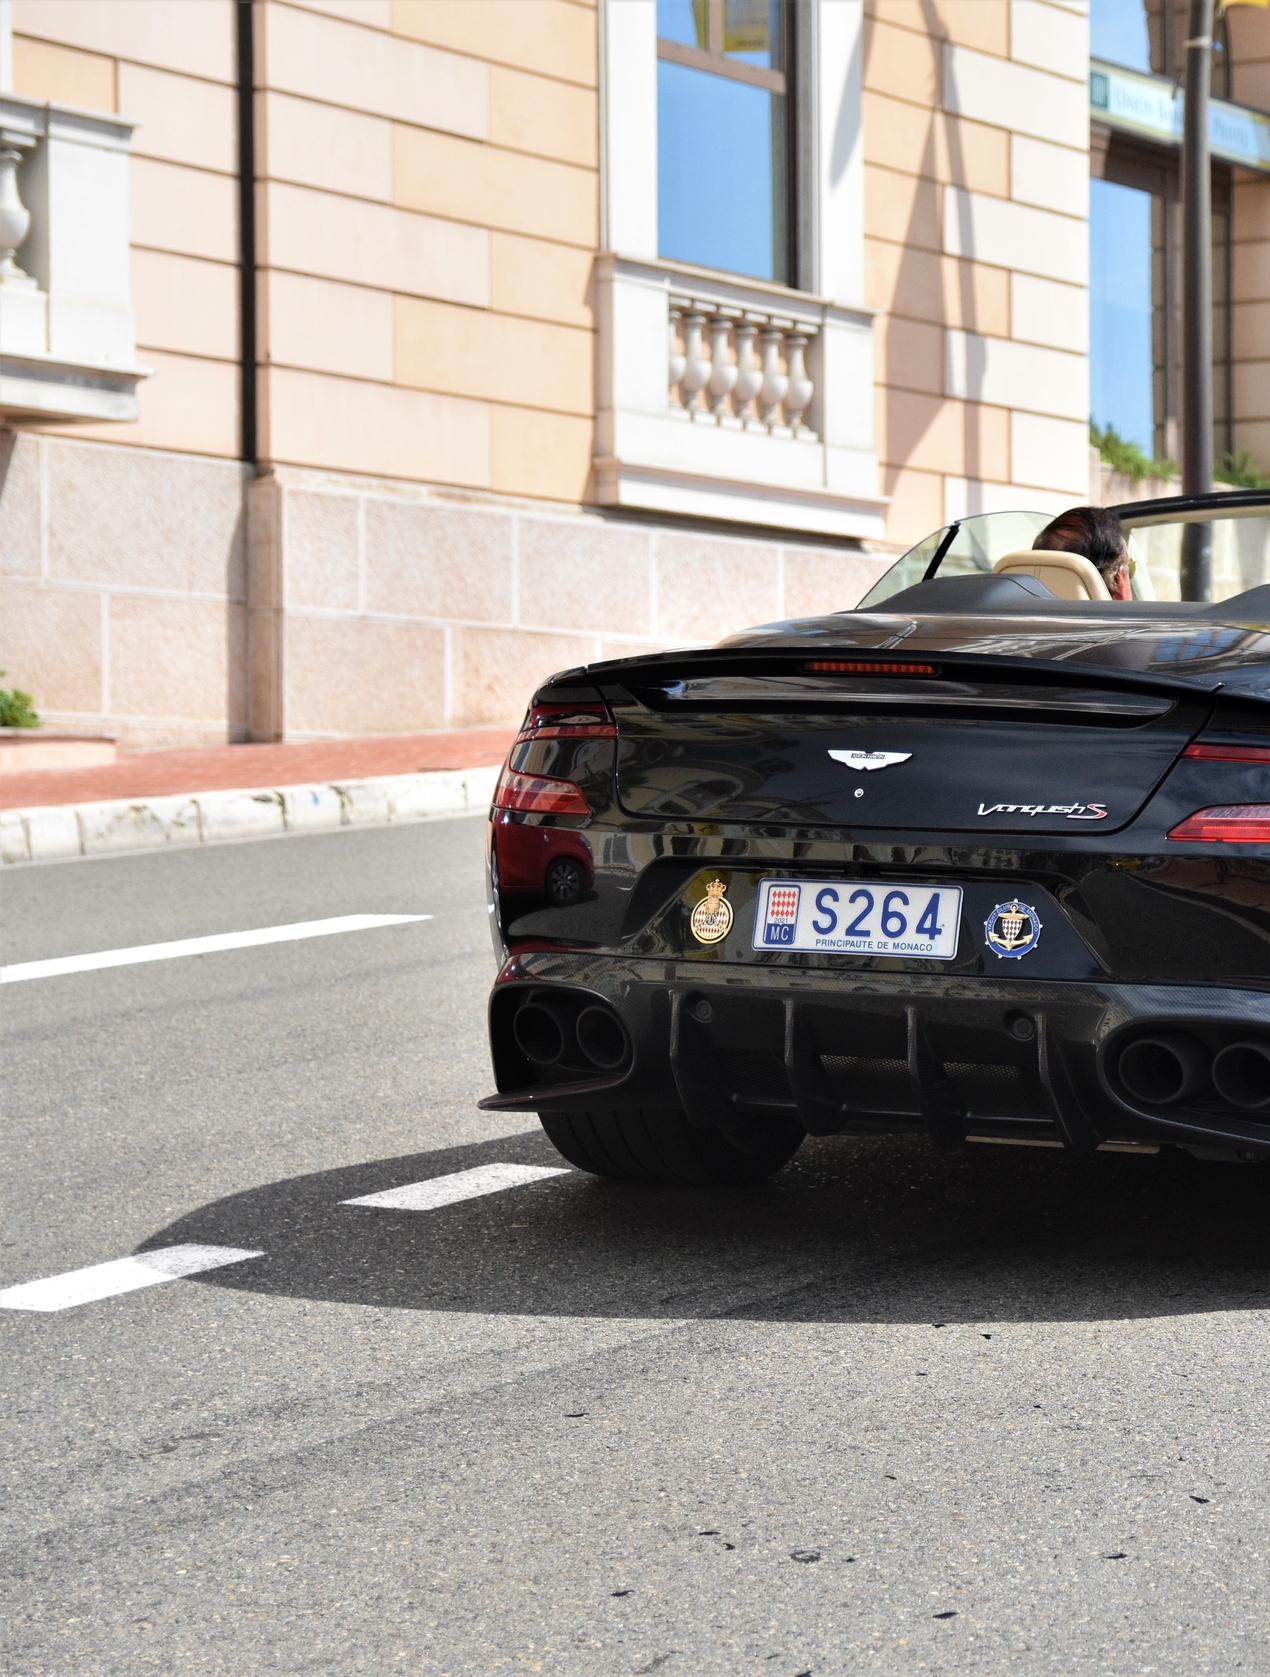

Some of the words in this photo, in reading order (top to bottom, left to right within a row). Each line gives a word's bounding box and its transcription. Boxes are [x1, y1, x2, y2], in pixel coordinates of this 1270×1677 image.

[978, 803, 1085, 817] Vanquish
[812, 888, 942, 940] S264
[987, 913, 998, 931] YACHT
[1026, 908, 1039, 932] MONACO
[770, 925, 790, 942] MC
[815, 938, 873, 949] PRINCIPAUTE
[876, 941, 889, 949] DE
[892, 942, 933, 952] MONACO
